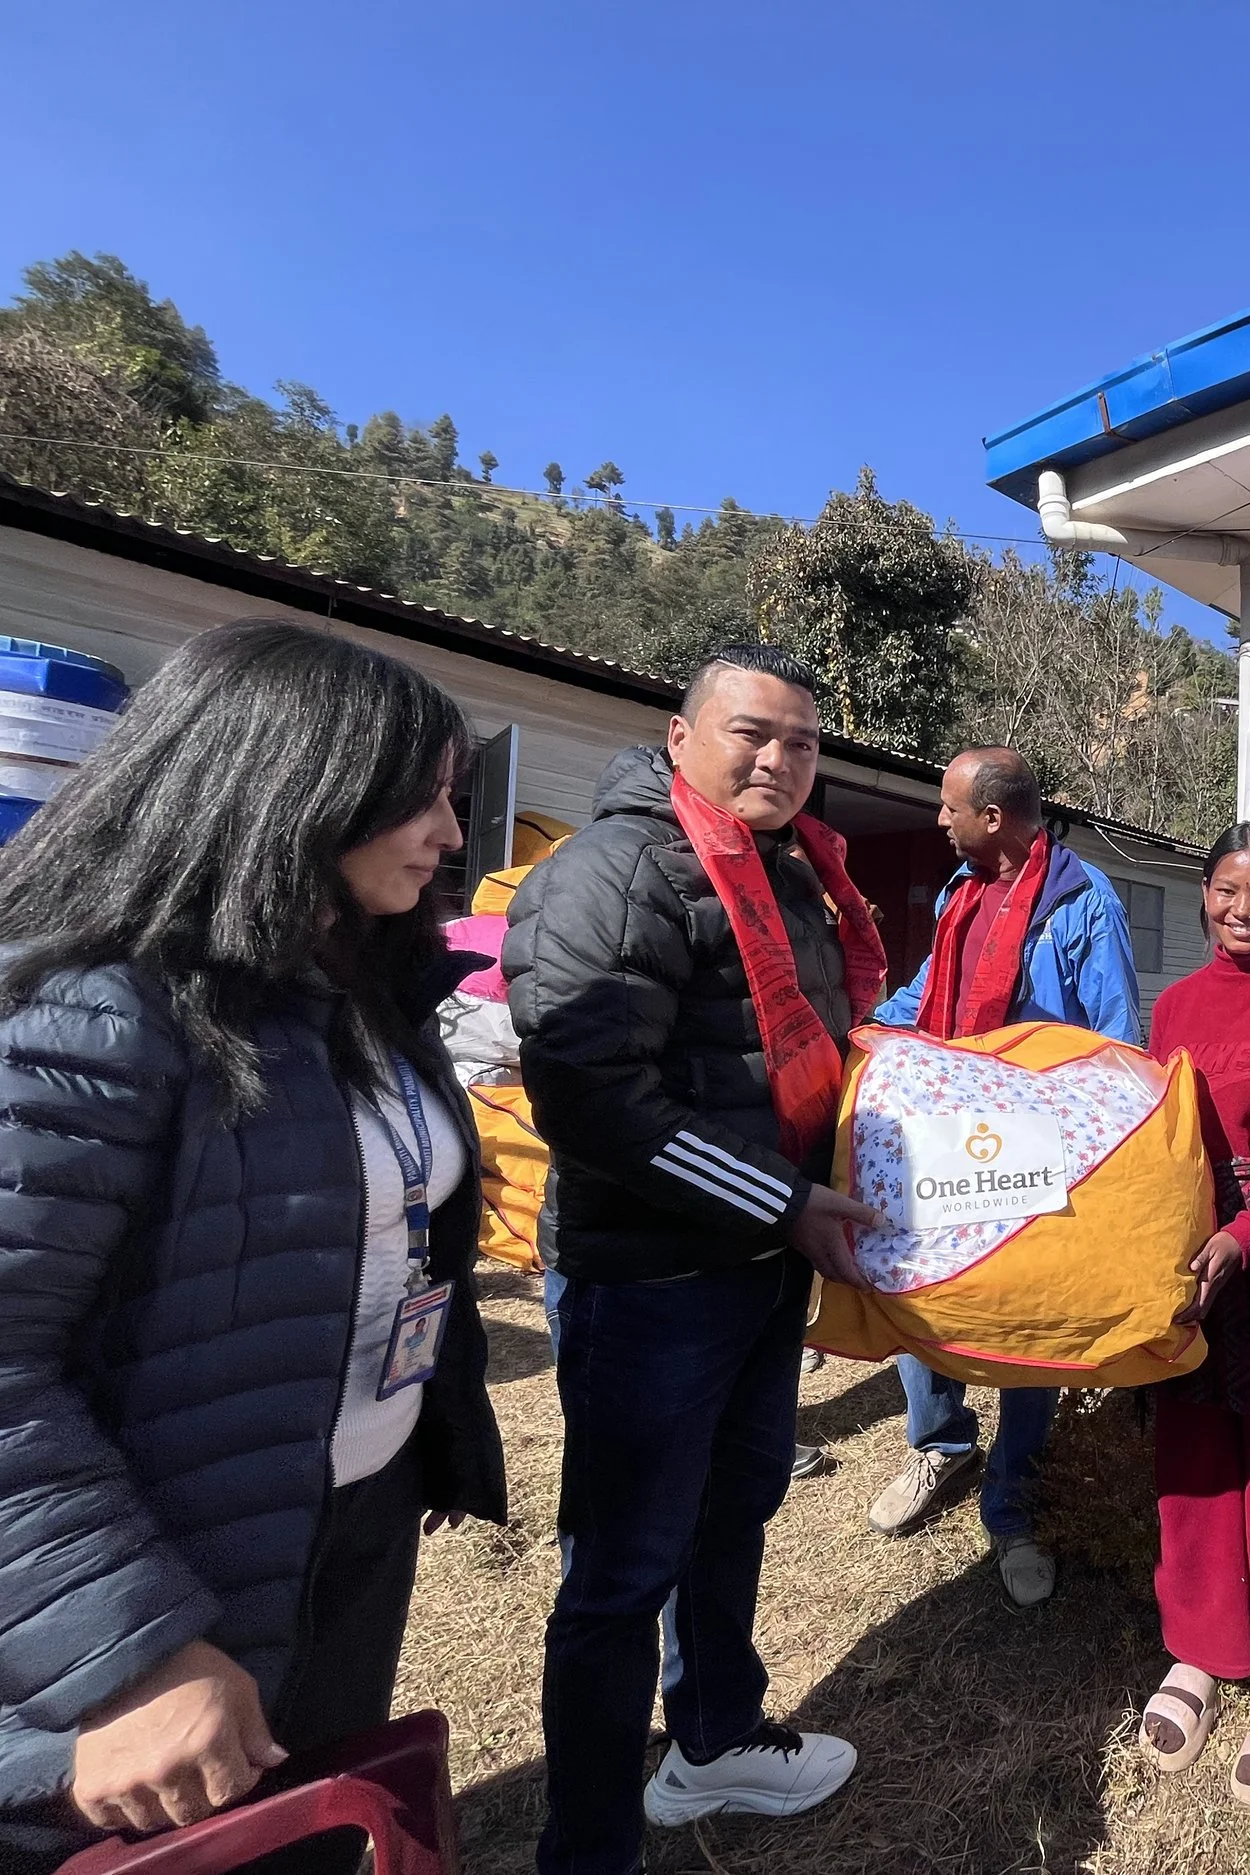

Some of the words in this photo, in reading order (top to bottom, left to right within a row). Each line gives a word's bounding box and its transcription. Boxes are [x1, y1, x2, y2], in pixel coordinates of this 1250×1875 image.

[916, 1177, 970, 1200] One
[975, 1166, 1053, 1193] Heart
[943, 1196, 1028, 1213] WORLDWIDE
